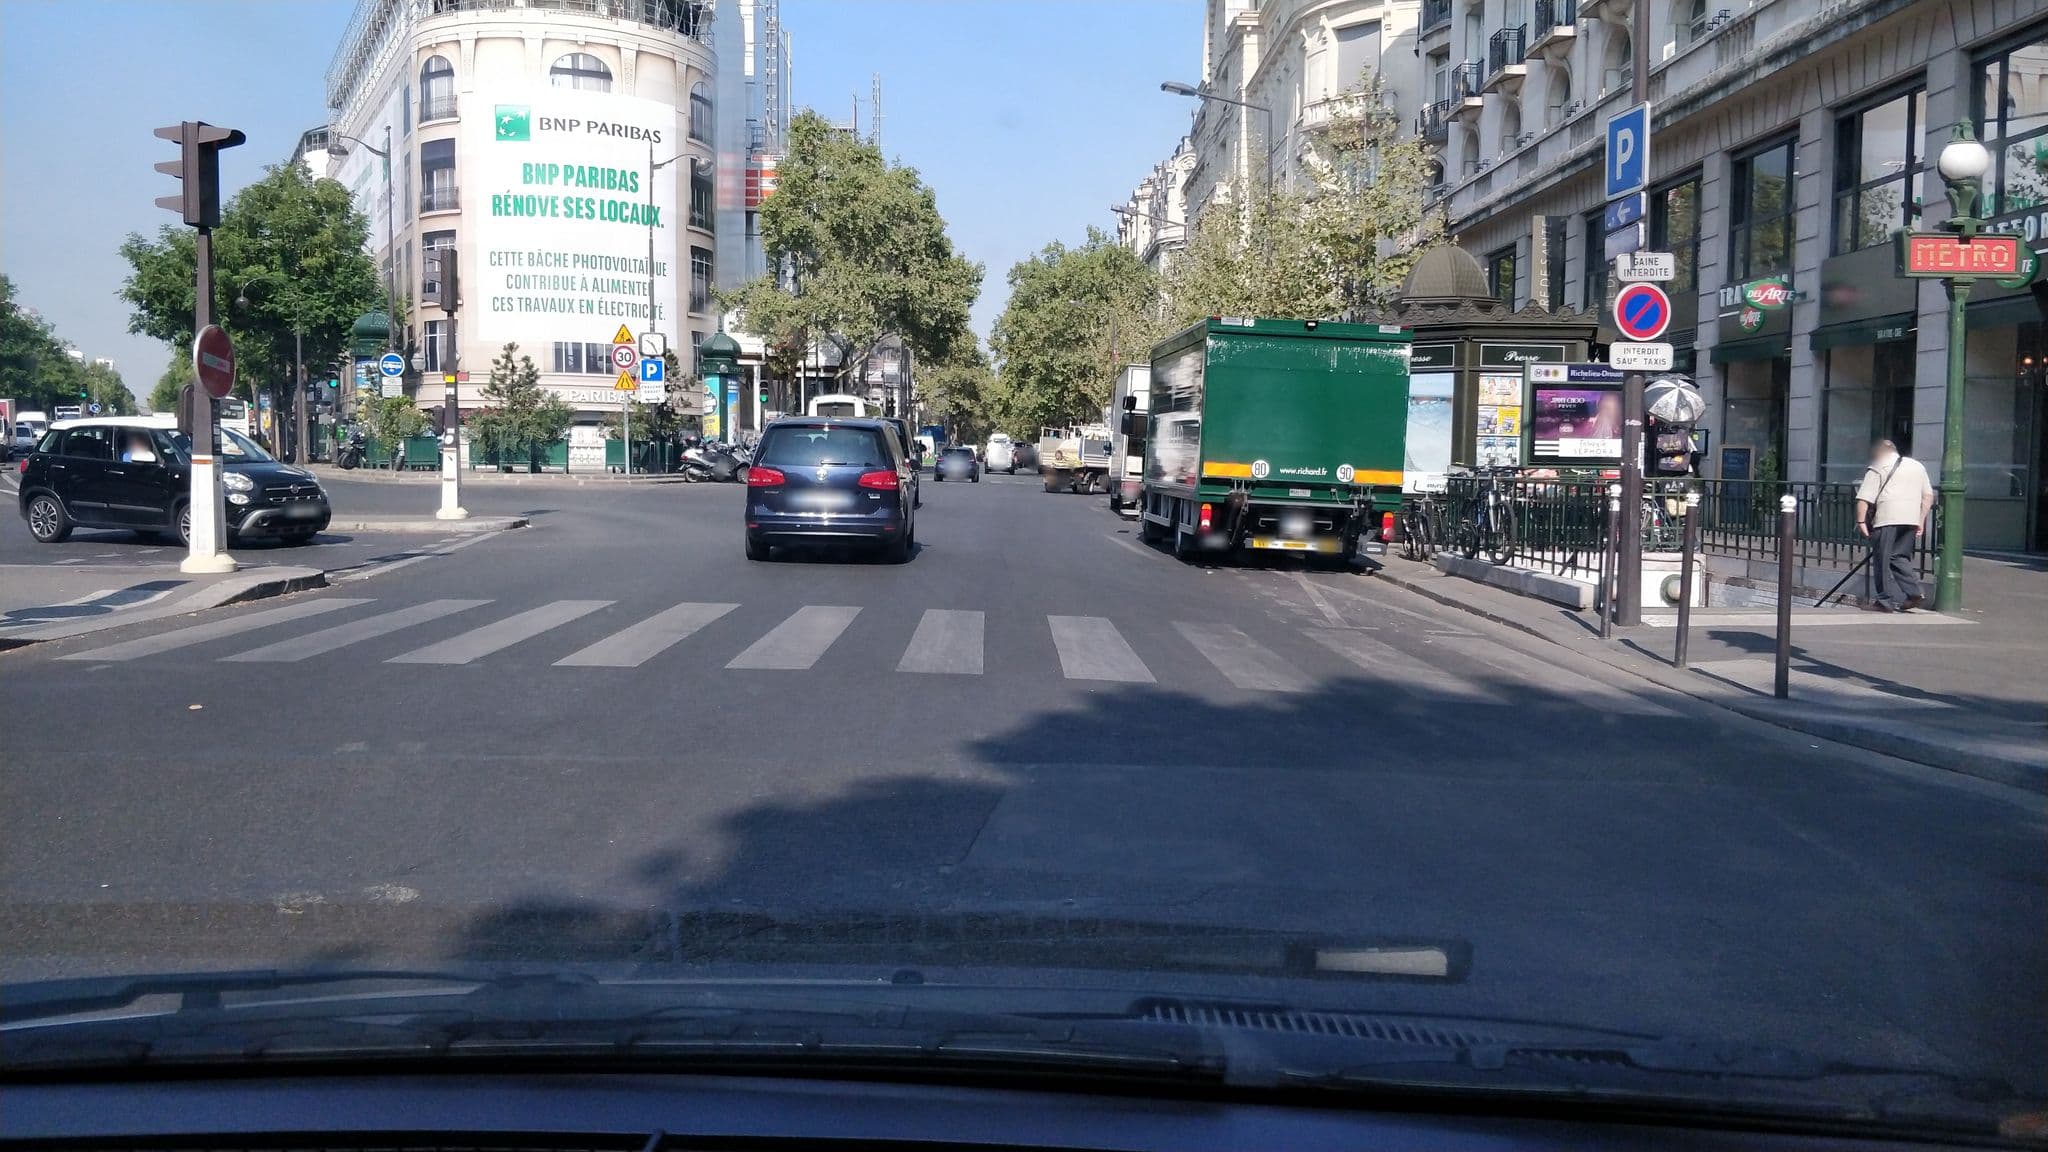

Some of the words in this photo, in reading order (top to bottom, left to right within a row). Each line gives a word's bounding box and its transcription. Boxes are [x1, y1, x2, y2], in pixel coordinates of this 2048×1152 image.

[539, 117, 581, 132] BNP
[586, 121, 662, 144] PARIBAS
[1616, 127, 1634, 181] P
[522, 162, 559, 185] BNP
[563, 164, 639, 193] PARIBAS
[492, 189, 559, 218] RÉNOVE
[563, 196, 596, 220] SES
[1916, 243, 2009, 267] METRO
[489, 251, 524, 267] CETTE
[573, 253, 667, 277] PHOTOVOLTAÏUE
[1623, 268, 1669, 277] INTERDITE
[506, 274, 576, 291] CONTRIBUE
[580, 273, 589, 292] À
[492, 296, 514, 312] CES
[517, 297, 575, 314] TRAVAUX
[579, 299, 594, 315] EN
[598, 297, 666, 320] ÉLECTRICTÉ.
[617, 352, 632, 363] 30
[1504, 350, 1541, 362] Presse
[1623, 347, 1660, 355] INTERDIT
[1644, 358, 1667, 366] TAXIS
[646, 363, 658, 379] P
[1254, 462, 1267, 476] 80
[1279, 466, 1328, 476] www.richard.fr
[1339, 466, 1352, 480] 90
